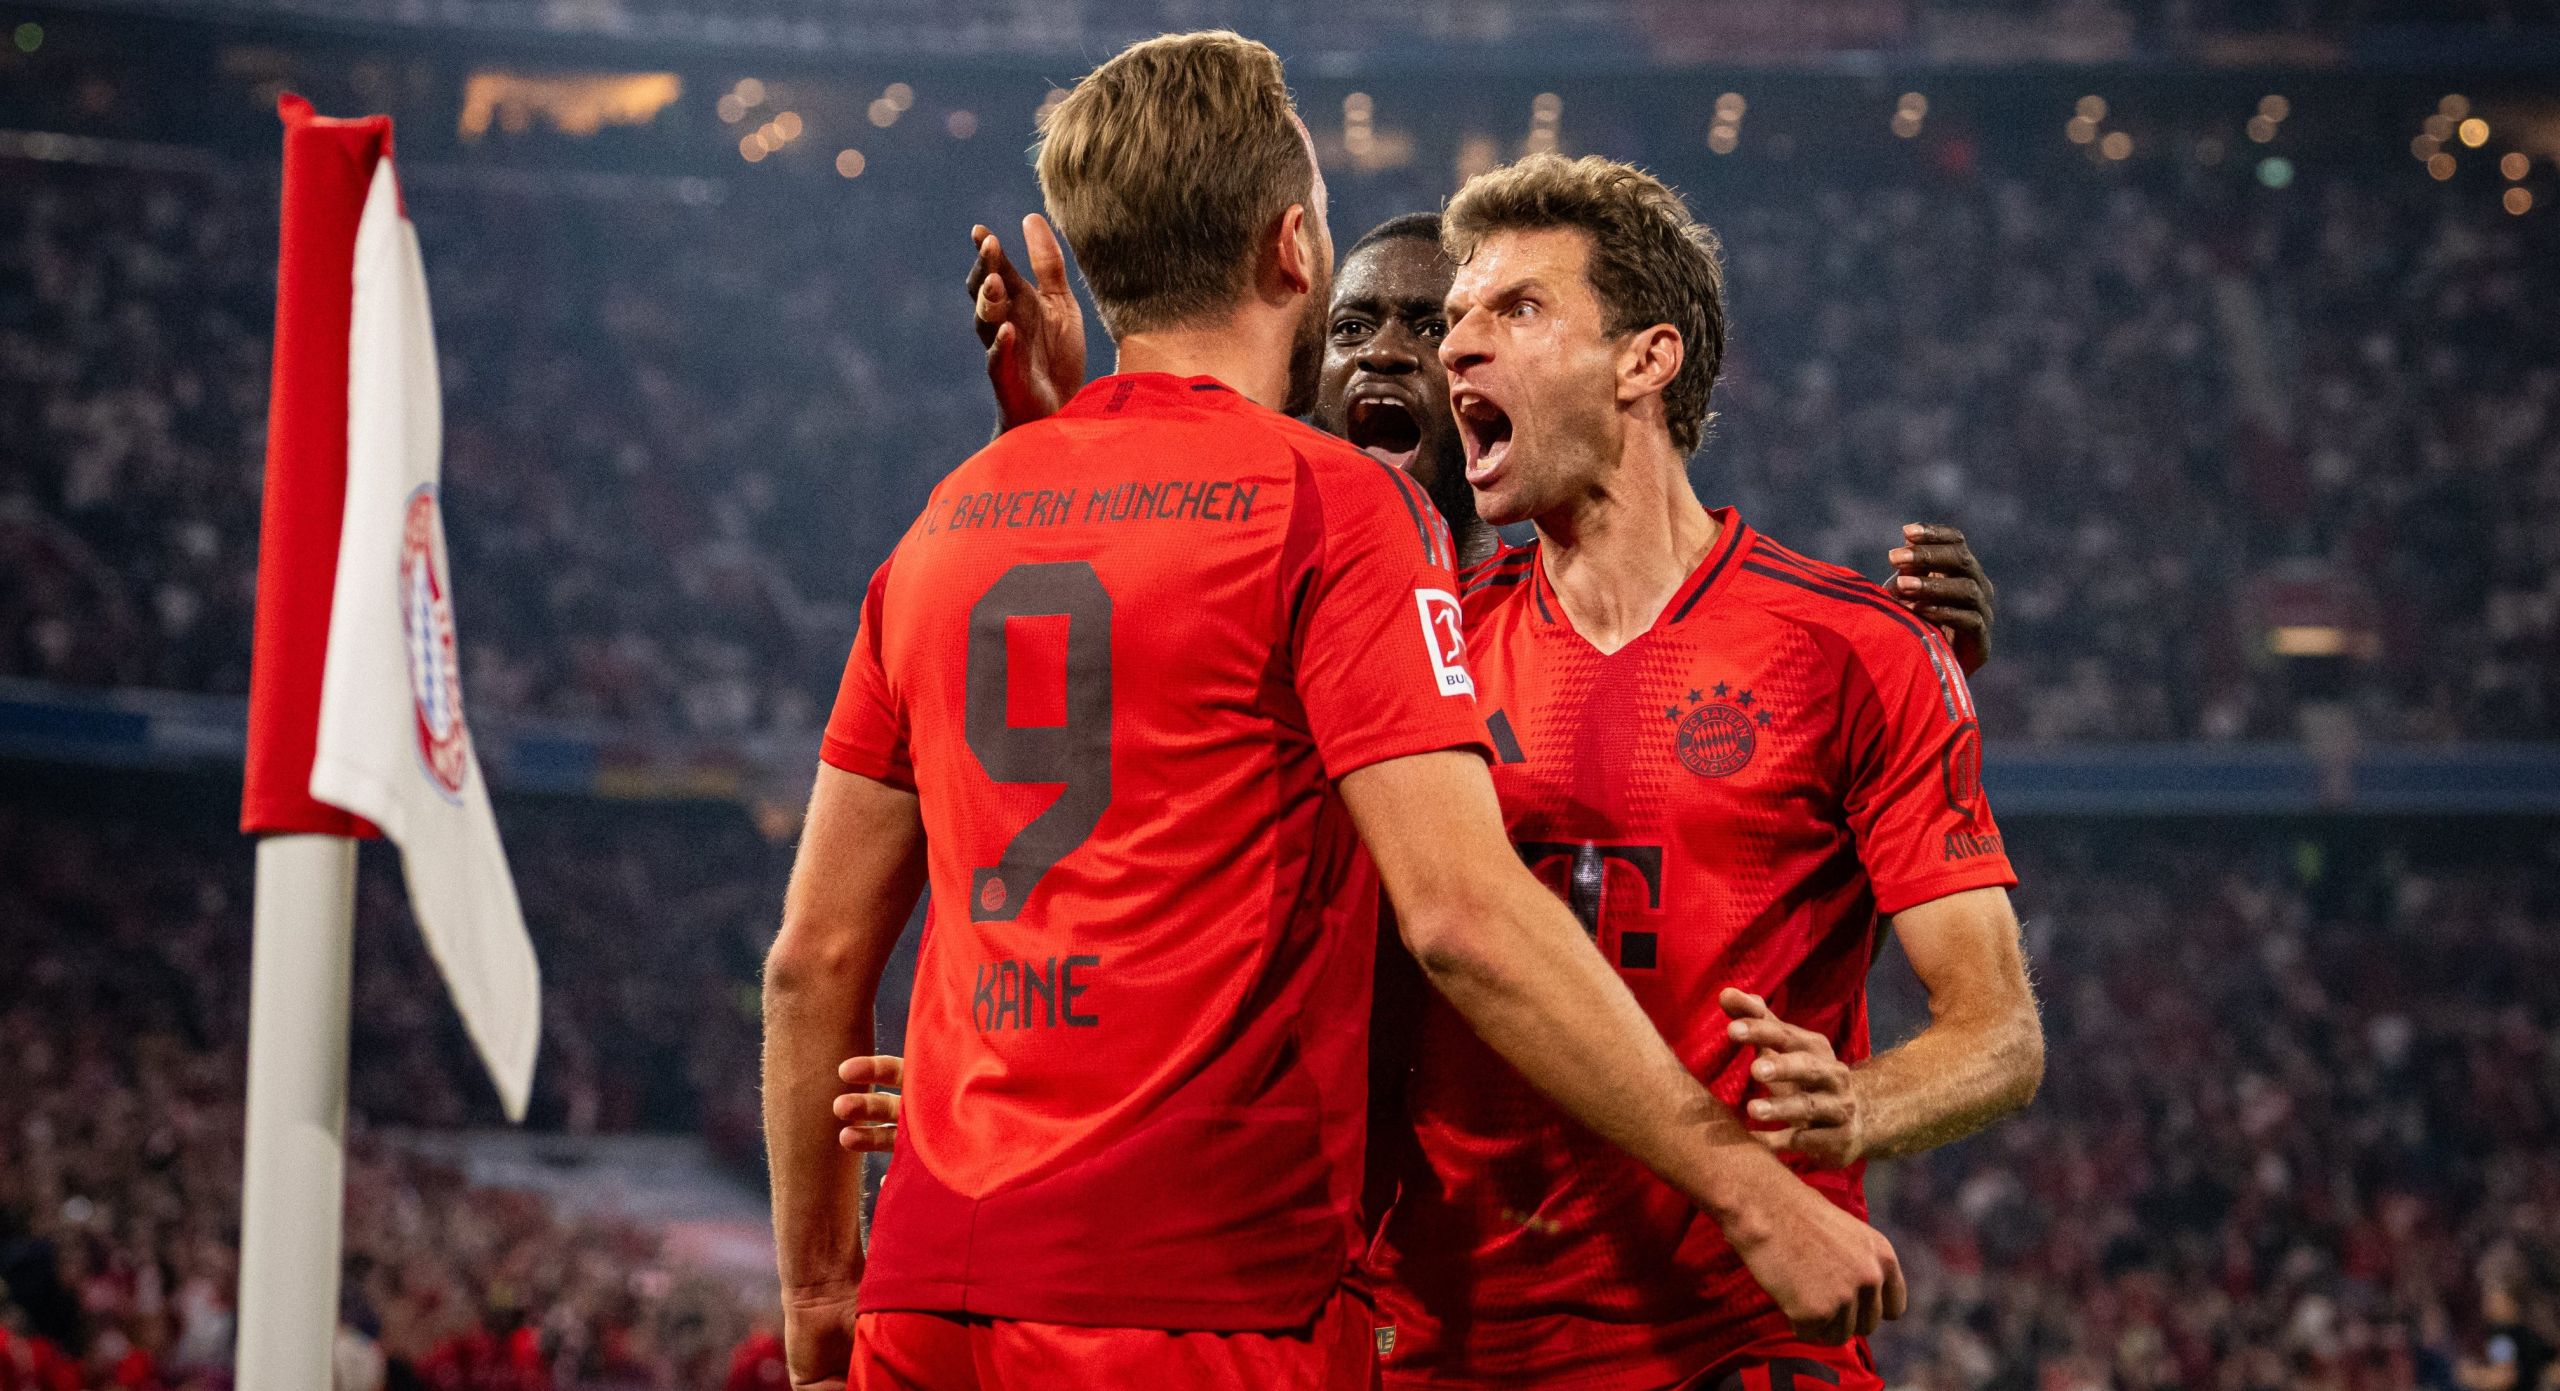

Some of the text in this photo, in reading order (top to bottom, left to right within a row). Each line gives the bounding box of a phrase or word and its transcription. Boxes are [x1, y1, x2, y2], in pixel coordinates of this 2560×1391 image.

[948, 488, 1078, 530] BAYERN
[1083, 480, 1260, 523] MÜNCHEN
[965, 560, 1113, 923] 9
[1683, 708, 1750, 737] FC BAYERN
[1944, 831, 2004, 862] Allian
[971, 954, 1100, 1033] KANE
